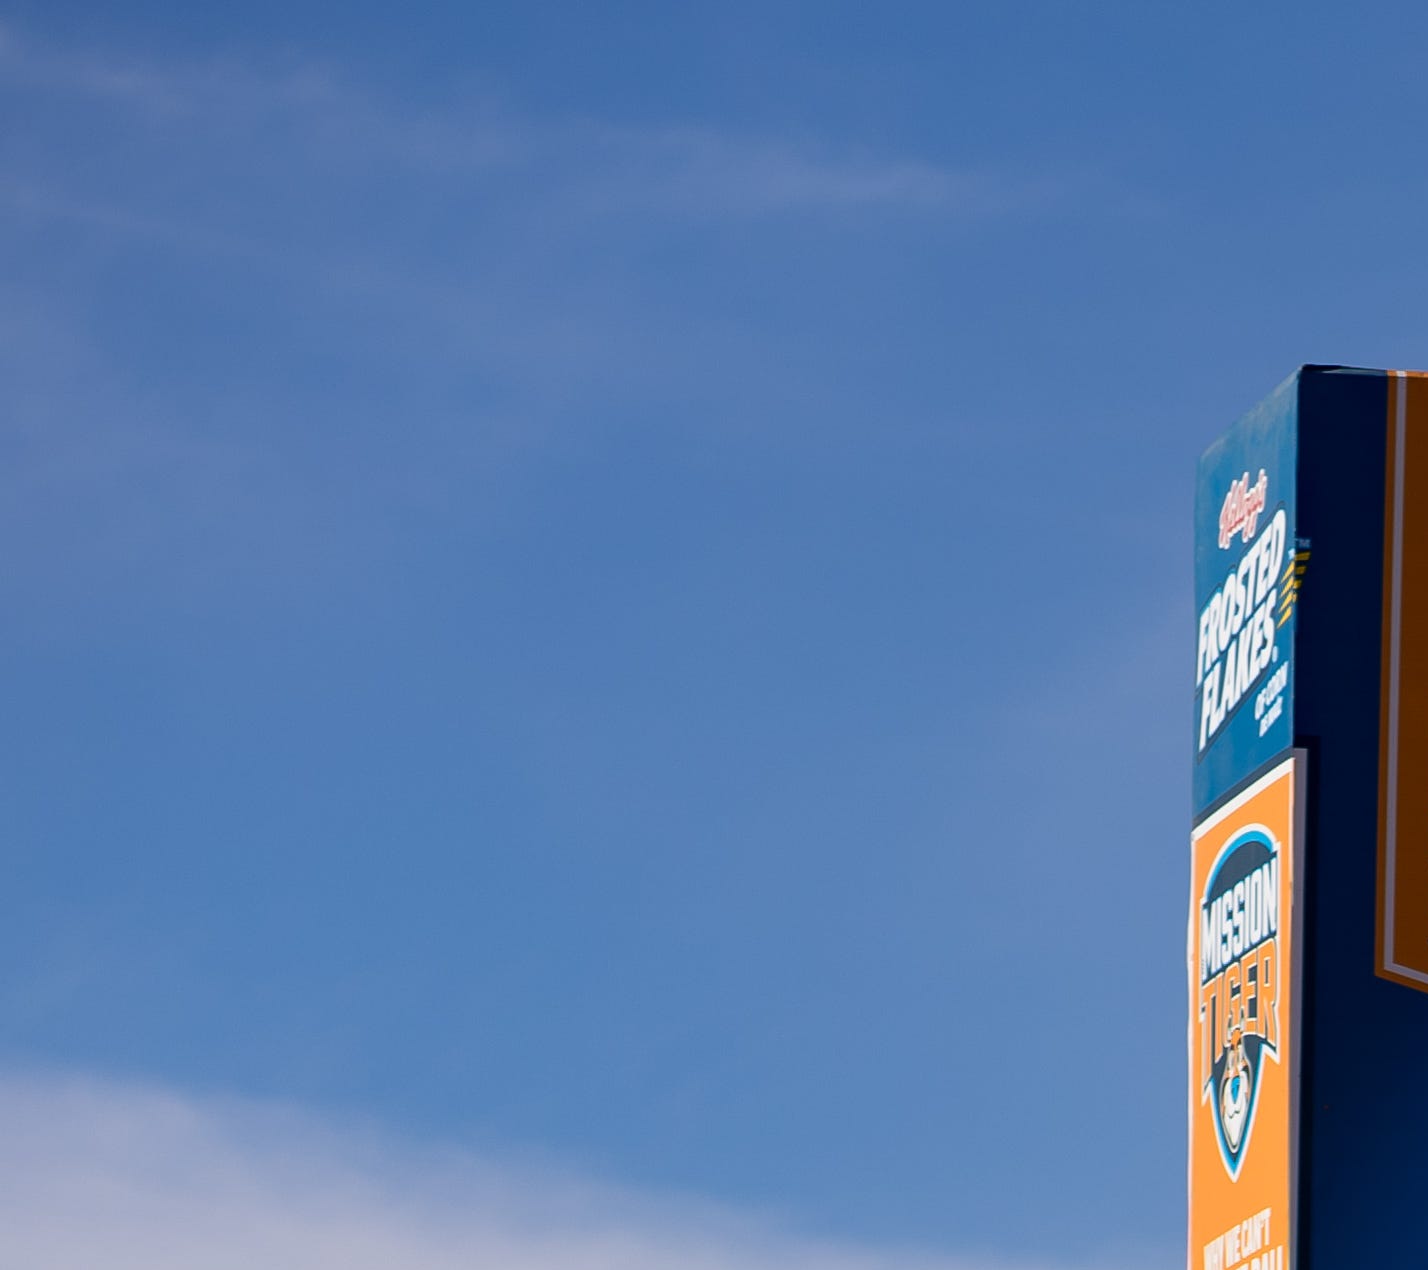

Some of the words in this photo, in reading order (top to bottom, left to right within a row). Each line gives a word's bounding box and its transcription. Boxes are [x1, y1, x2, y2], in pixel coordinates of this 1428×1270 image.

[1218, 468, 1268, 549] Kellogg's
[1196, 509, 1286, 688] FROSTED
[1199, 588, 1276, 751] FLAKES
[1202, 856, 1277, 983] MISSION
[1202, 939, 1277, 1093] TIGER
[1225, 1225, 1240, 1269] WE
[1241, 1208, 1272, 1257] CAN'T
